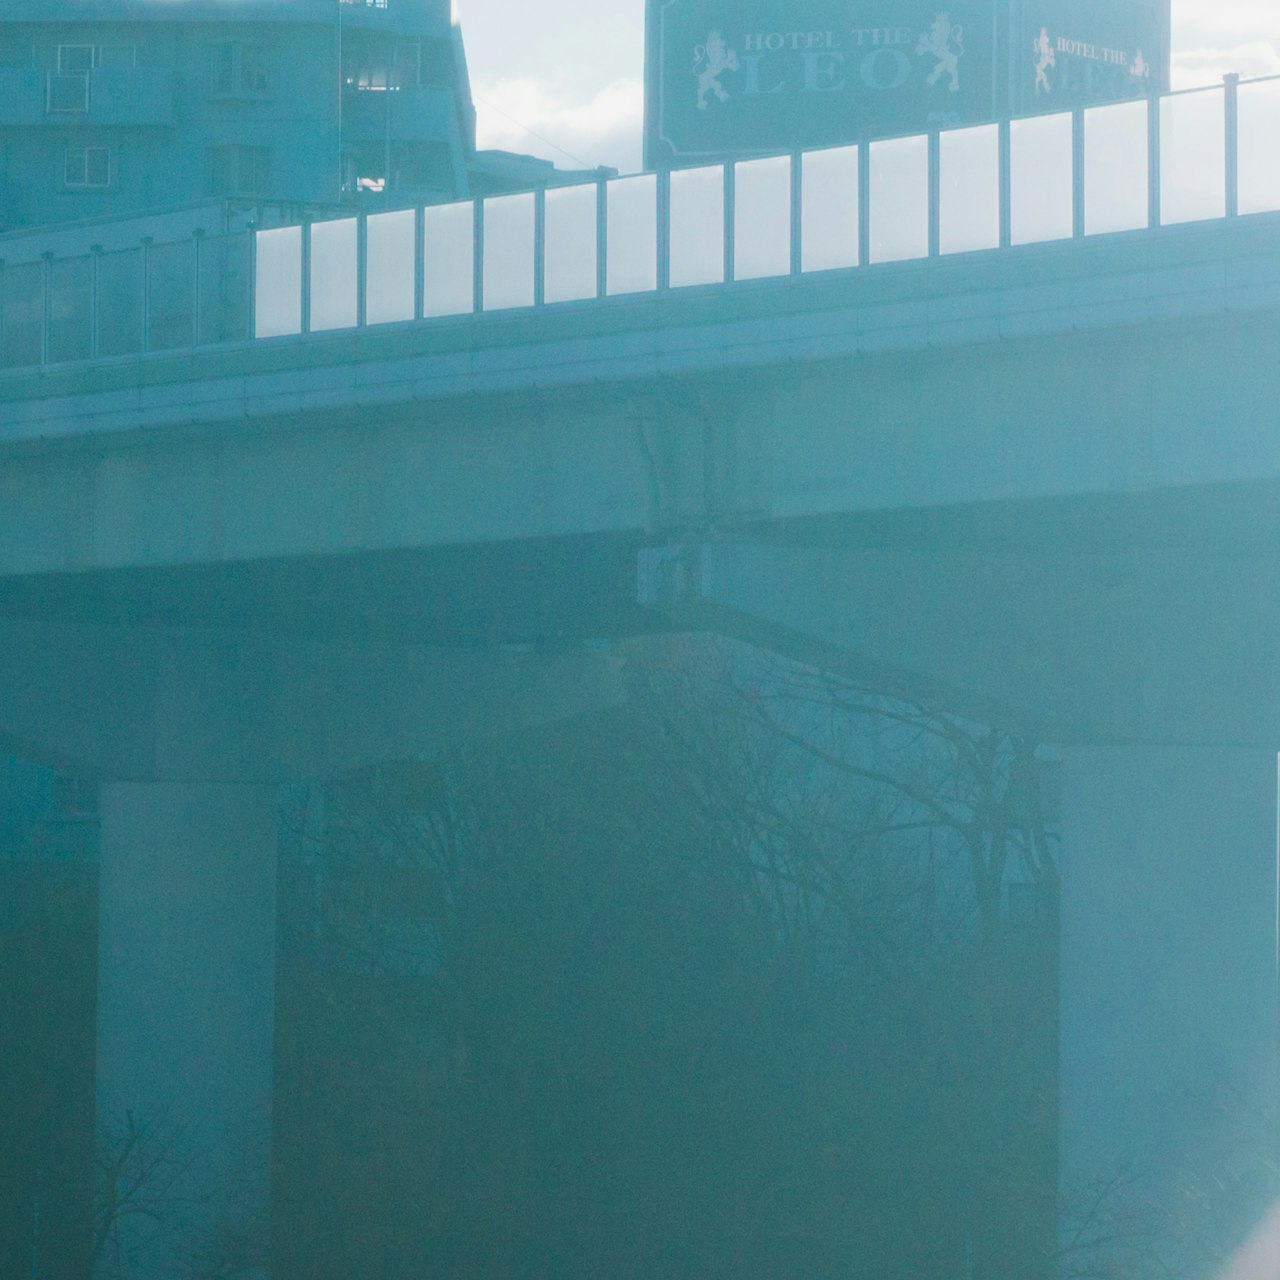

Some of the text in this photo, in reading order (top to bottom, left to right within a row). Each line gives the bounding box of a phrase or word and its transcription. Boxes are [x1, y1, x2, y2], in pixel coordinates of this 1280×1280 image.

[743, 27, 912, 51] HOTEL THE
[1056, 36, 1128, 66] HOTEL THE
[739, 48, 912, 96] LEO
